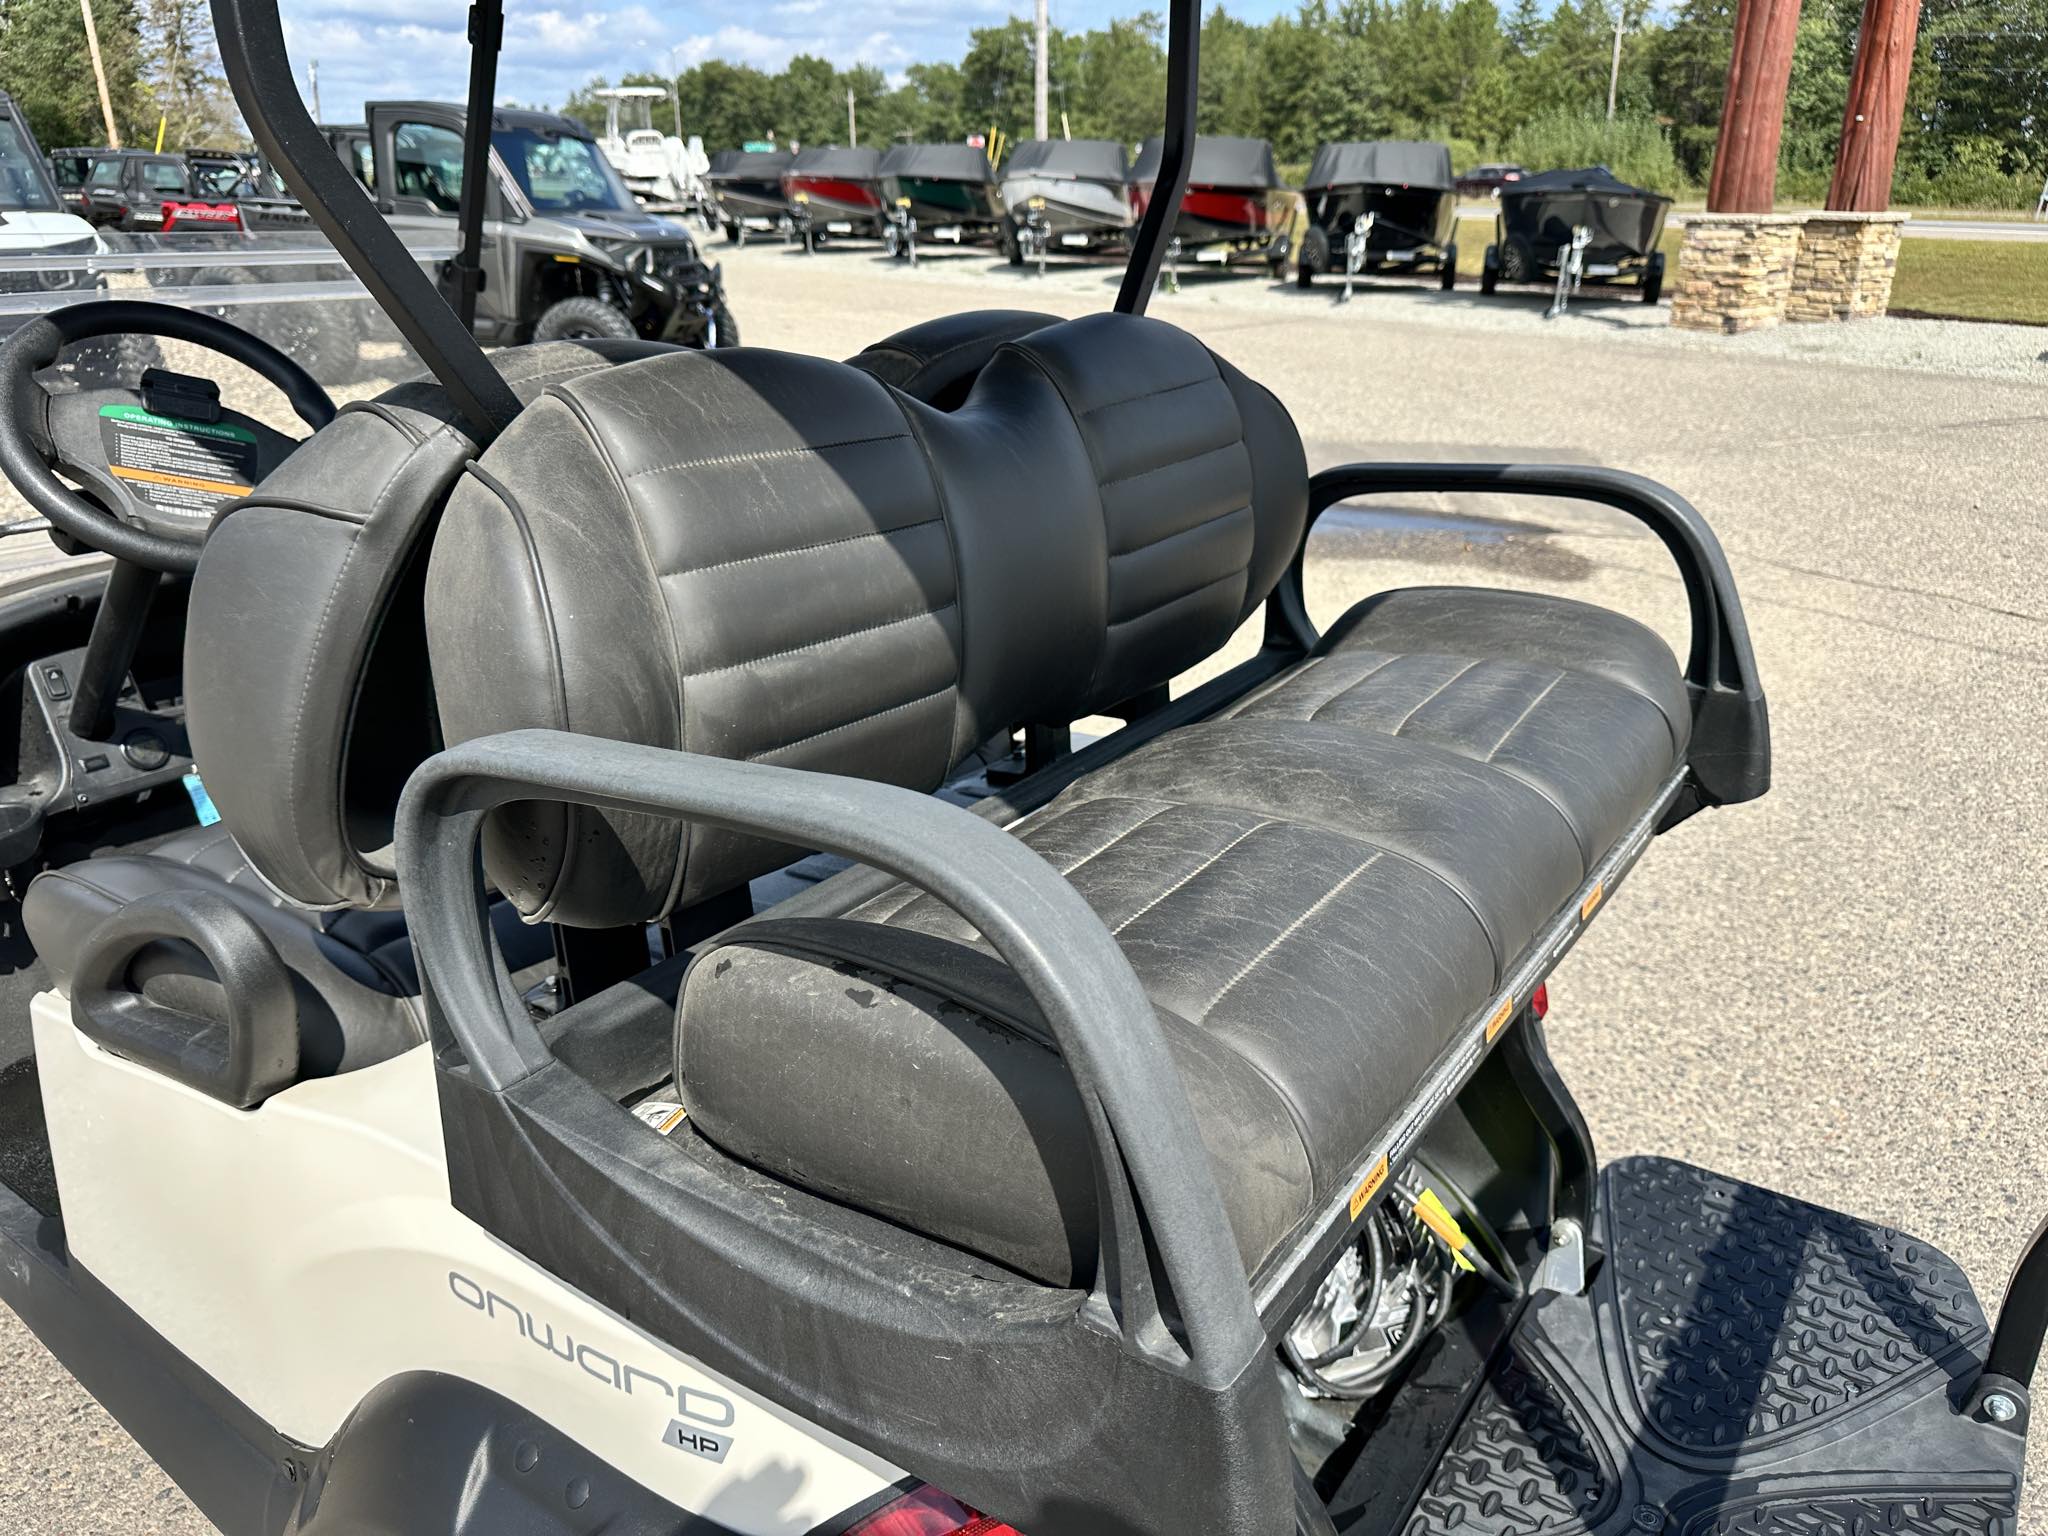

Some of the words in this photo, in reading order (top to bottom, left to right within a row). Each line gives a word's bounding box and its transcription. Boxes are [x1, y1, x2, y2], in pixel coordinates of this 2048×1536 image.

[123, 412, 174, 427] OPERATING
[175, 422, 236, 438] INSTRUCTIONS
[163, 477, 206, 488] WARNING
[1357, 1164, 1387, 1204] WARNING
[678, 1428, 719, 1453] HP
